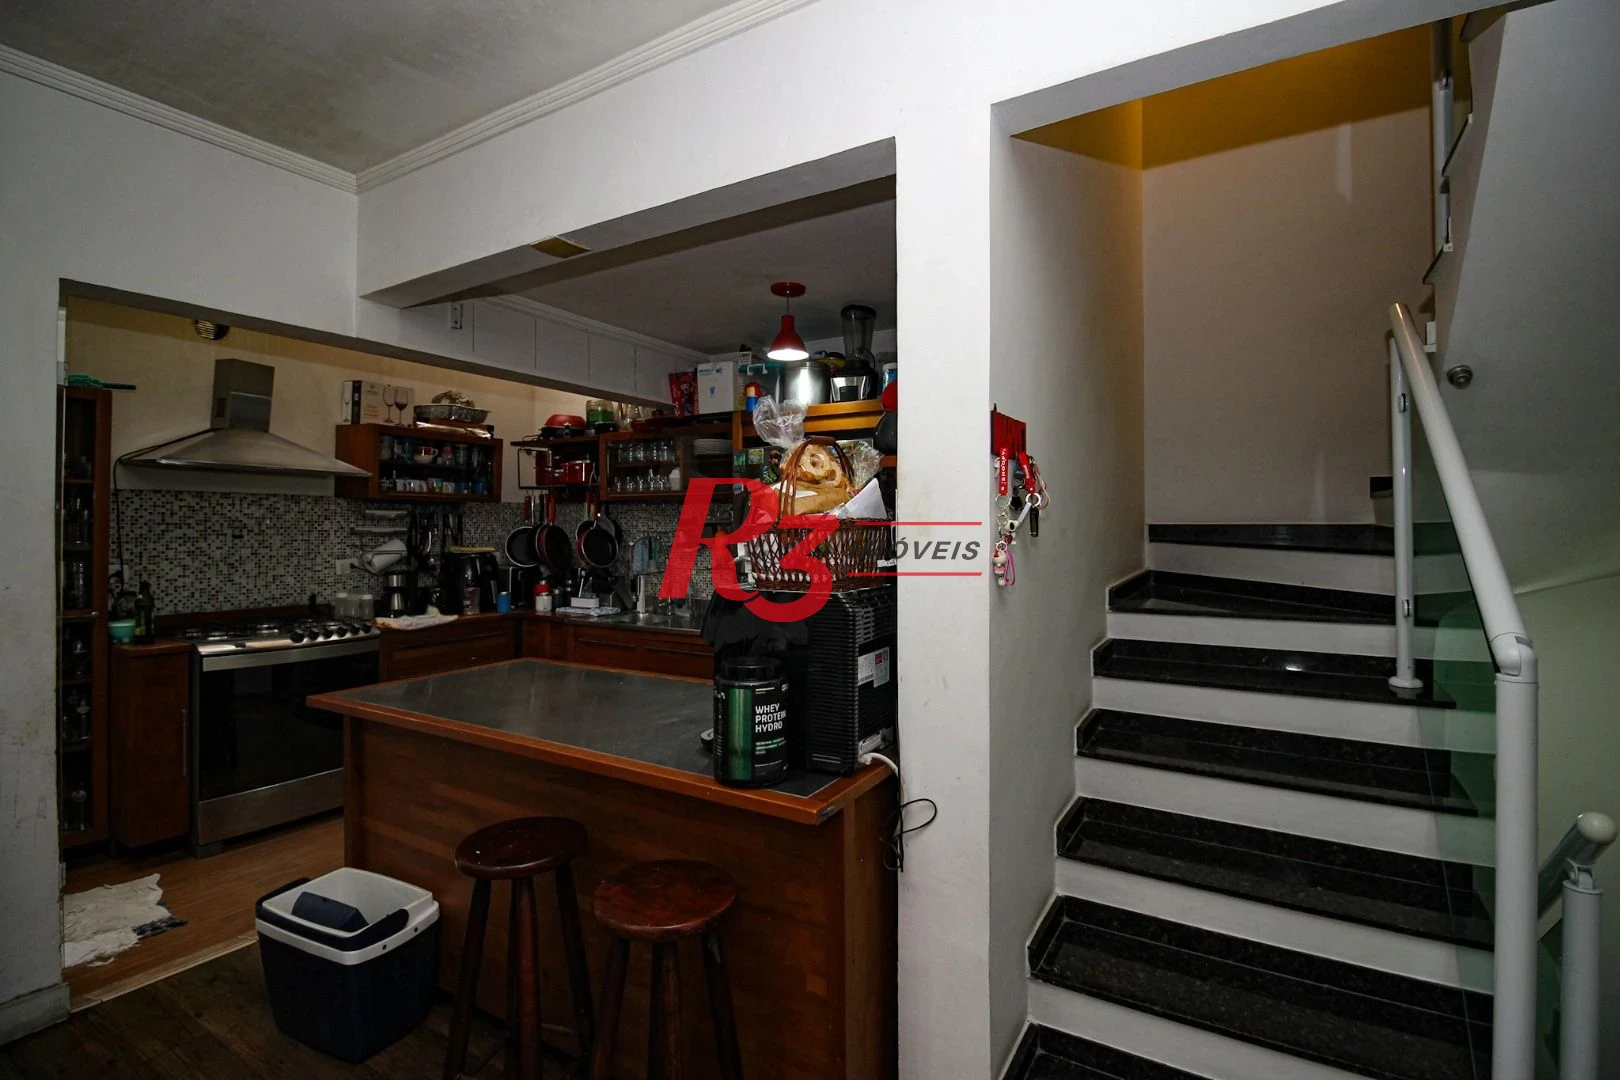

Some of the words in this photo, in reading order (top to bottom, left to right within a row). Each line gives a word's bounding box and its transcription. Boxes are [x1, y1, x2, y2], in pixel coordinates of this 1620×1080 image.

[755, 703, 780, 714] WHEY
[755, 710, 787, 723] PROTEIN
[755, 721, 783, 733] HYDRO
